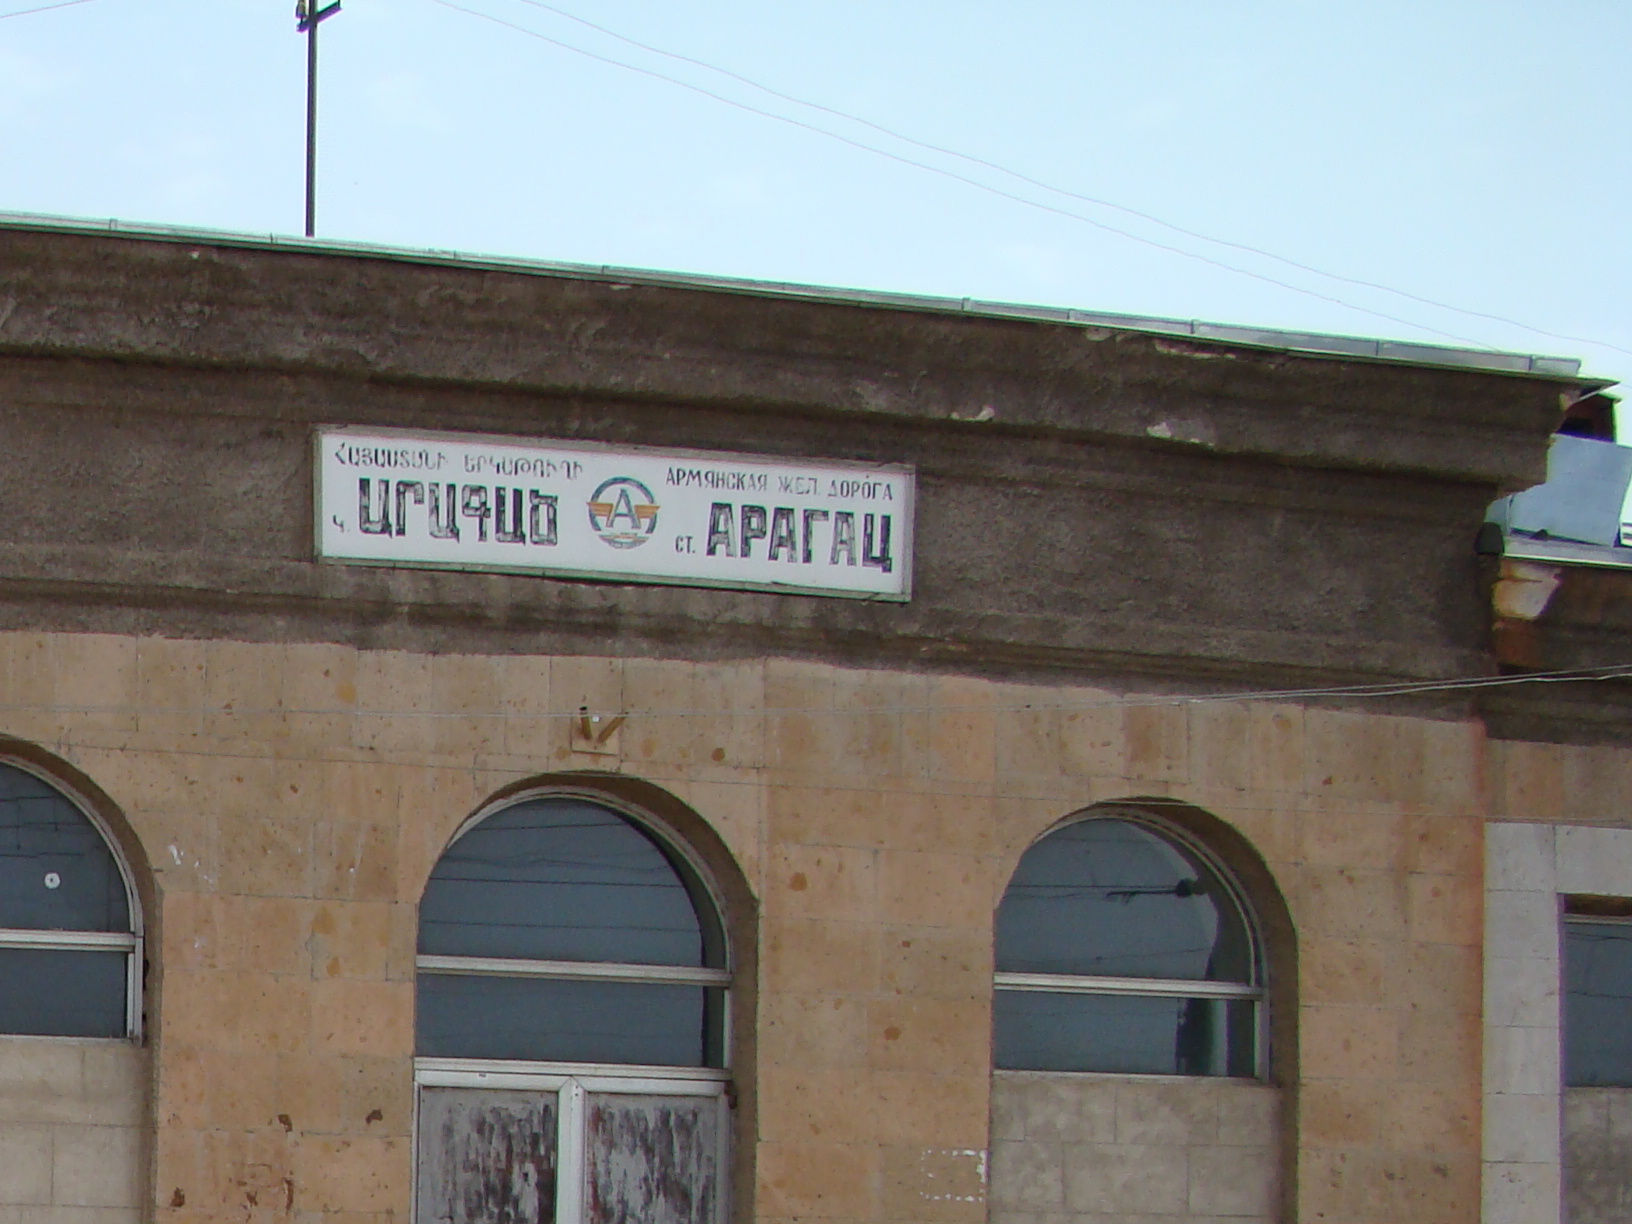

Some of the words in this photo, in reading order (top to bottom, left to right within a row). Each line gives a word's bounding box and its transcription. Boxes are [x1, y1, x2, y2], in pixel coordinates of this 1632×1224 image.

[334, 441, 448, 471] ՀԱՅԱՍՏԱՆԻ
[666, 466, 767, 491] АРМЯНСКАЯ
[827, 475, 893, 501] ДОРОГА
[358, 477, 558, 547] ԱՐԱԳԱԾ
[705, 501, 892, 573] АРАГАЦ
